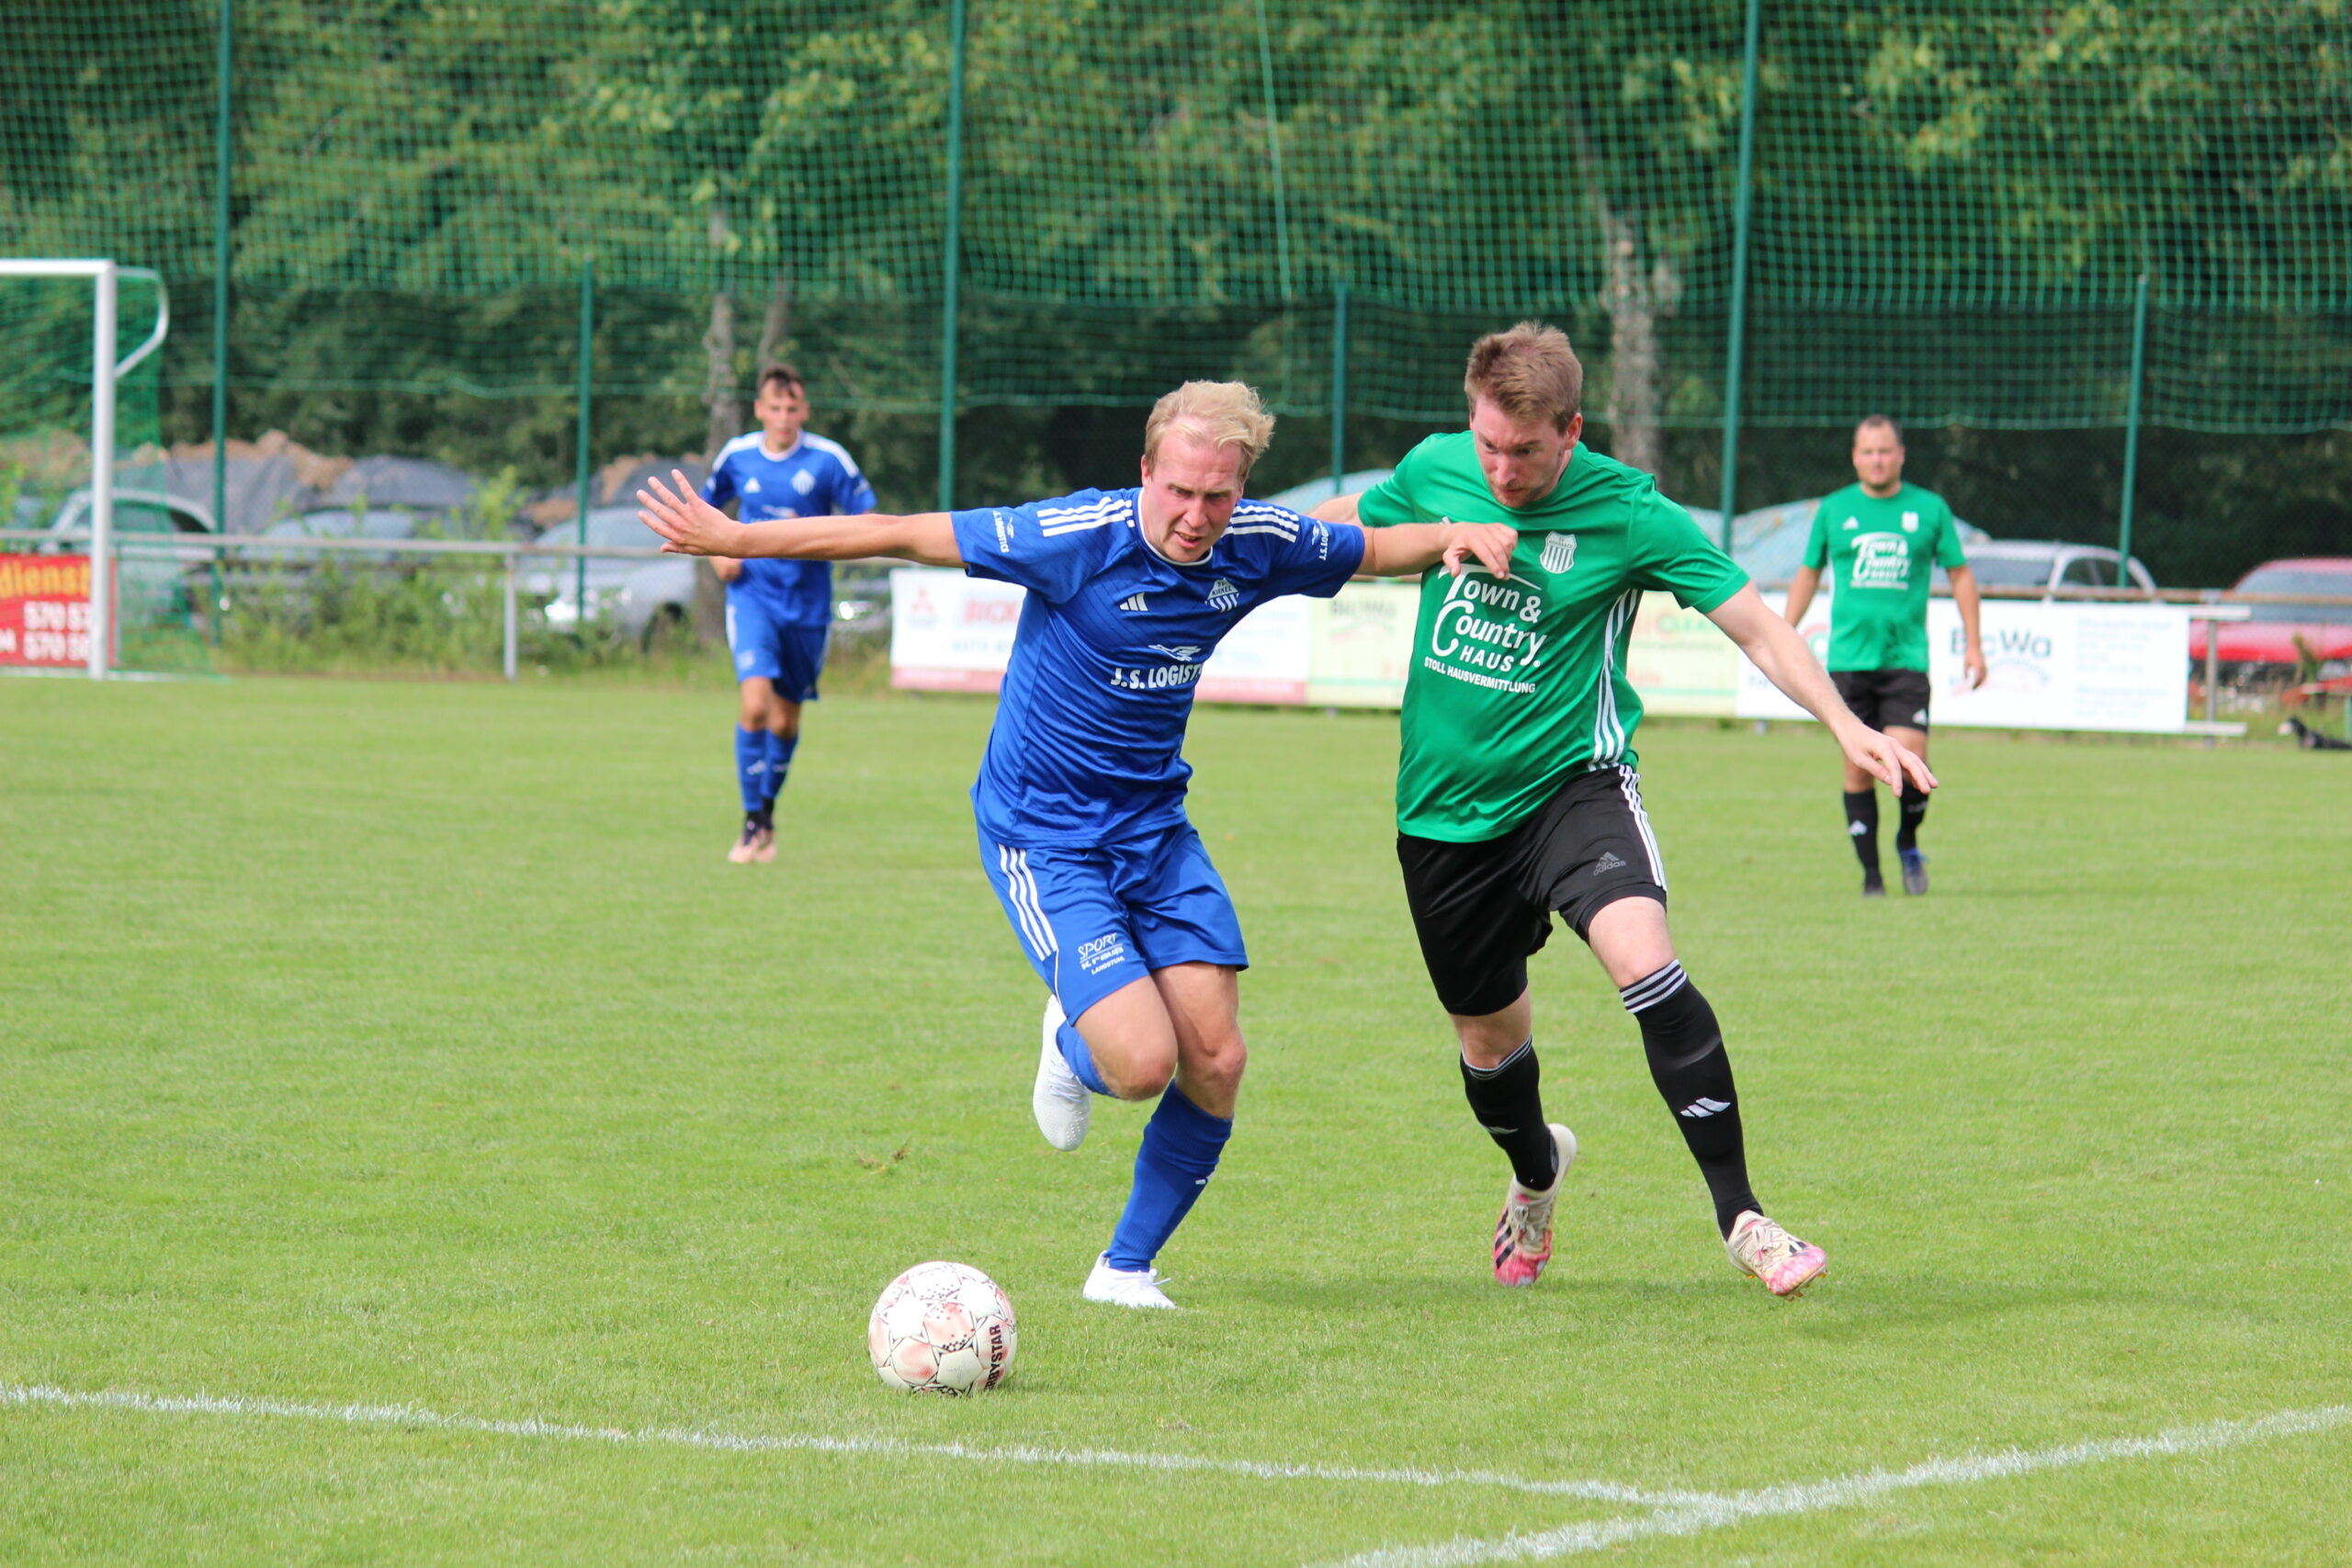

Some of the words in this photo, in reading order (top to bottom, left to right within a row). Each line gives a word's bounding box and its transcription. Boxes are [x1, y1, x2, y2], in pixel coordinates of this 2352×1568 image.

[1438, 563, 1543, 611] Town
[1519, 595, 1542, 624] &
[1431, 599, 1548, 667] Country
[1459, 645, 1514, 672] HAUS
[1110, 667, 1146, 690] J.S.
[1424, 656, 1445, 674] STOLL
[1447, 664, 1536, 694] HAUSVERMITTLUNG
[1079, 932, 1117, 959] SPORT
